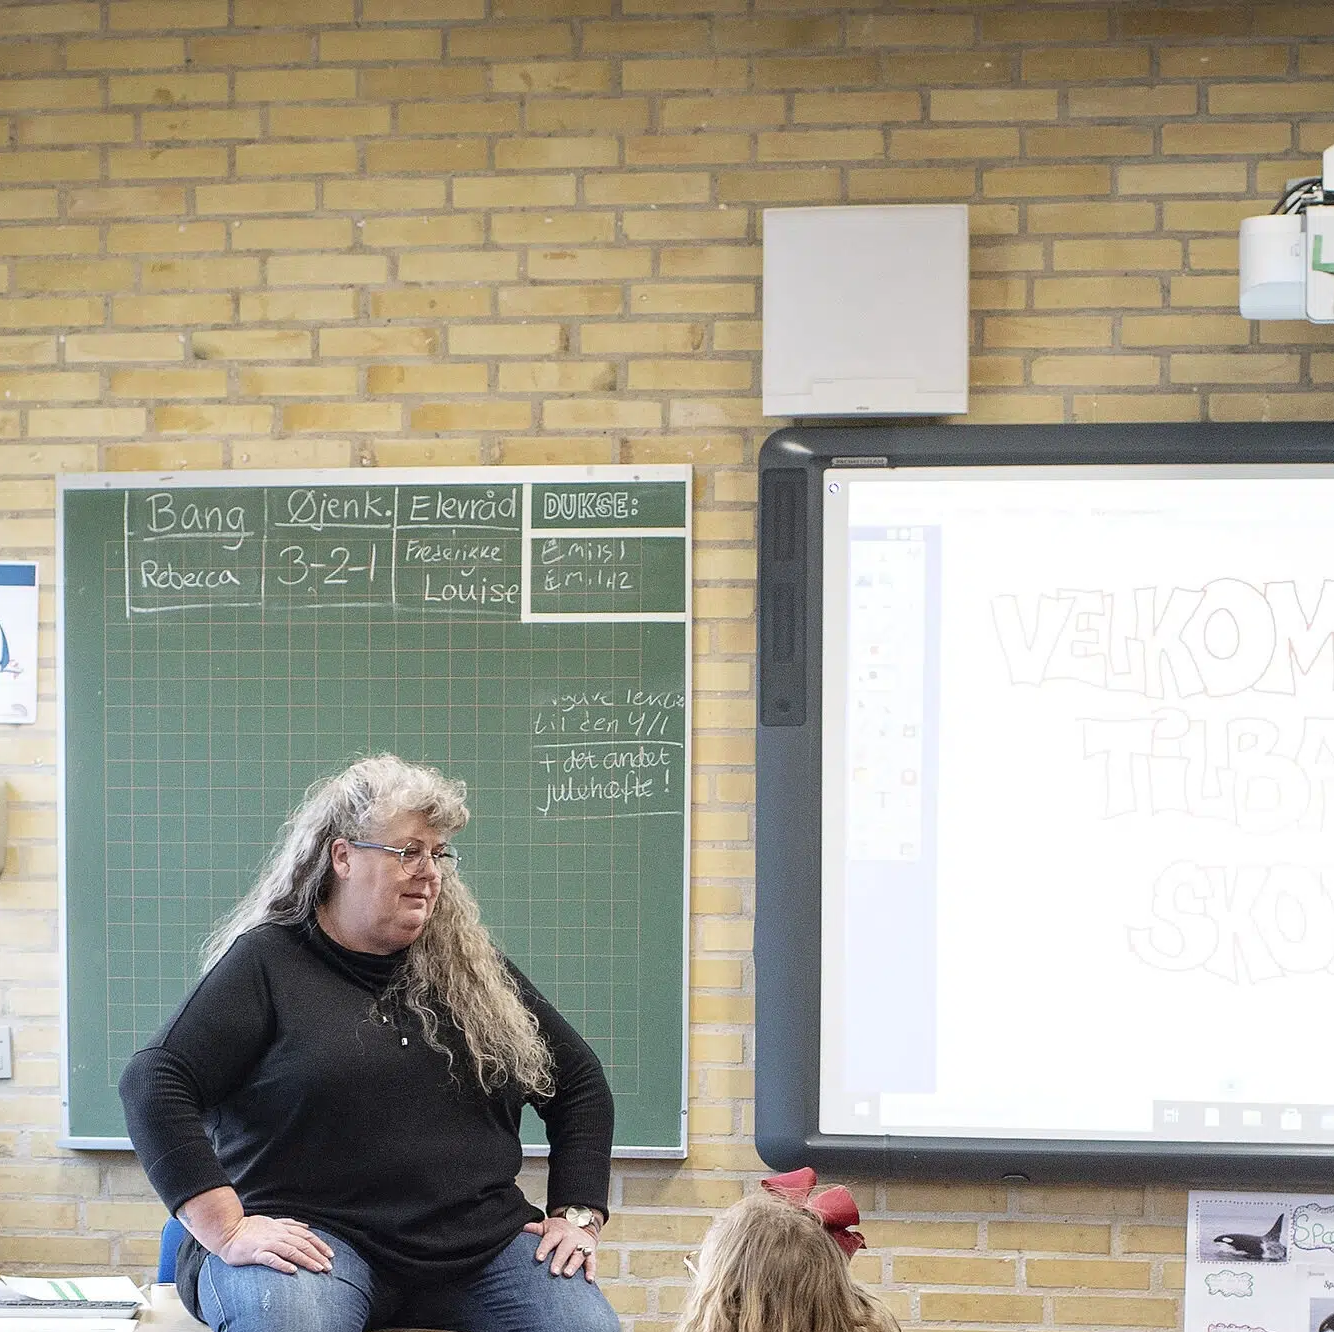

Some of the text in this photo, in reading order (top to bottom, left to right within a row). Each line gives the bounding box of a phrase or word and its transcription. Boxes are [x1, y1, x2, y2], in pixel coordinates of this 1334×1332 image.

[410, 487, 517, 521] Elevråd
[543, 491, 639, 519] DUKSE:
[146, 493, 245, 550] Bang
[141, 560, 240, 589] Rebecca
[424, 574, 519, 604] Louise
[533, 712, 566, 734] til
[580, 711, 618, 733] den
[563, 749, 599, 772] det
[603, 746, 670, 768] andet
